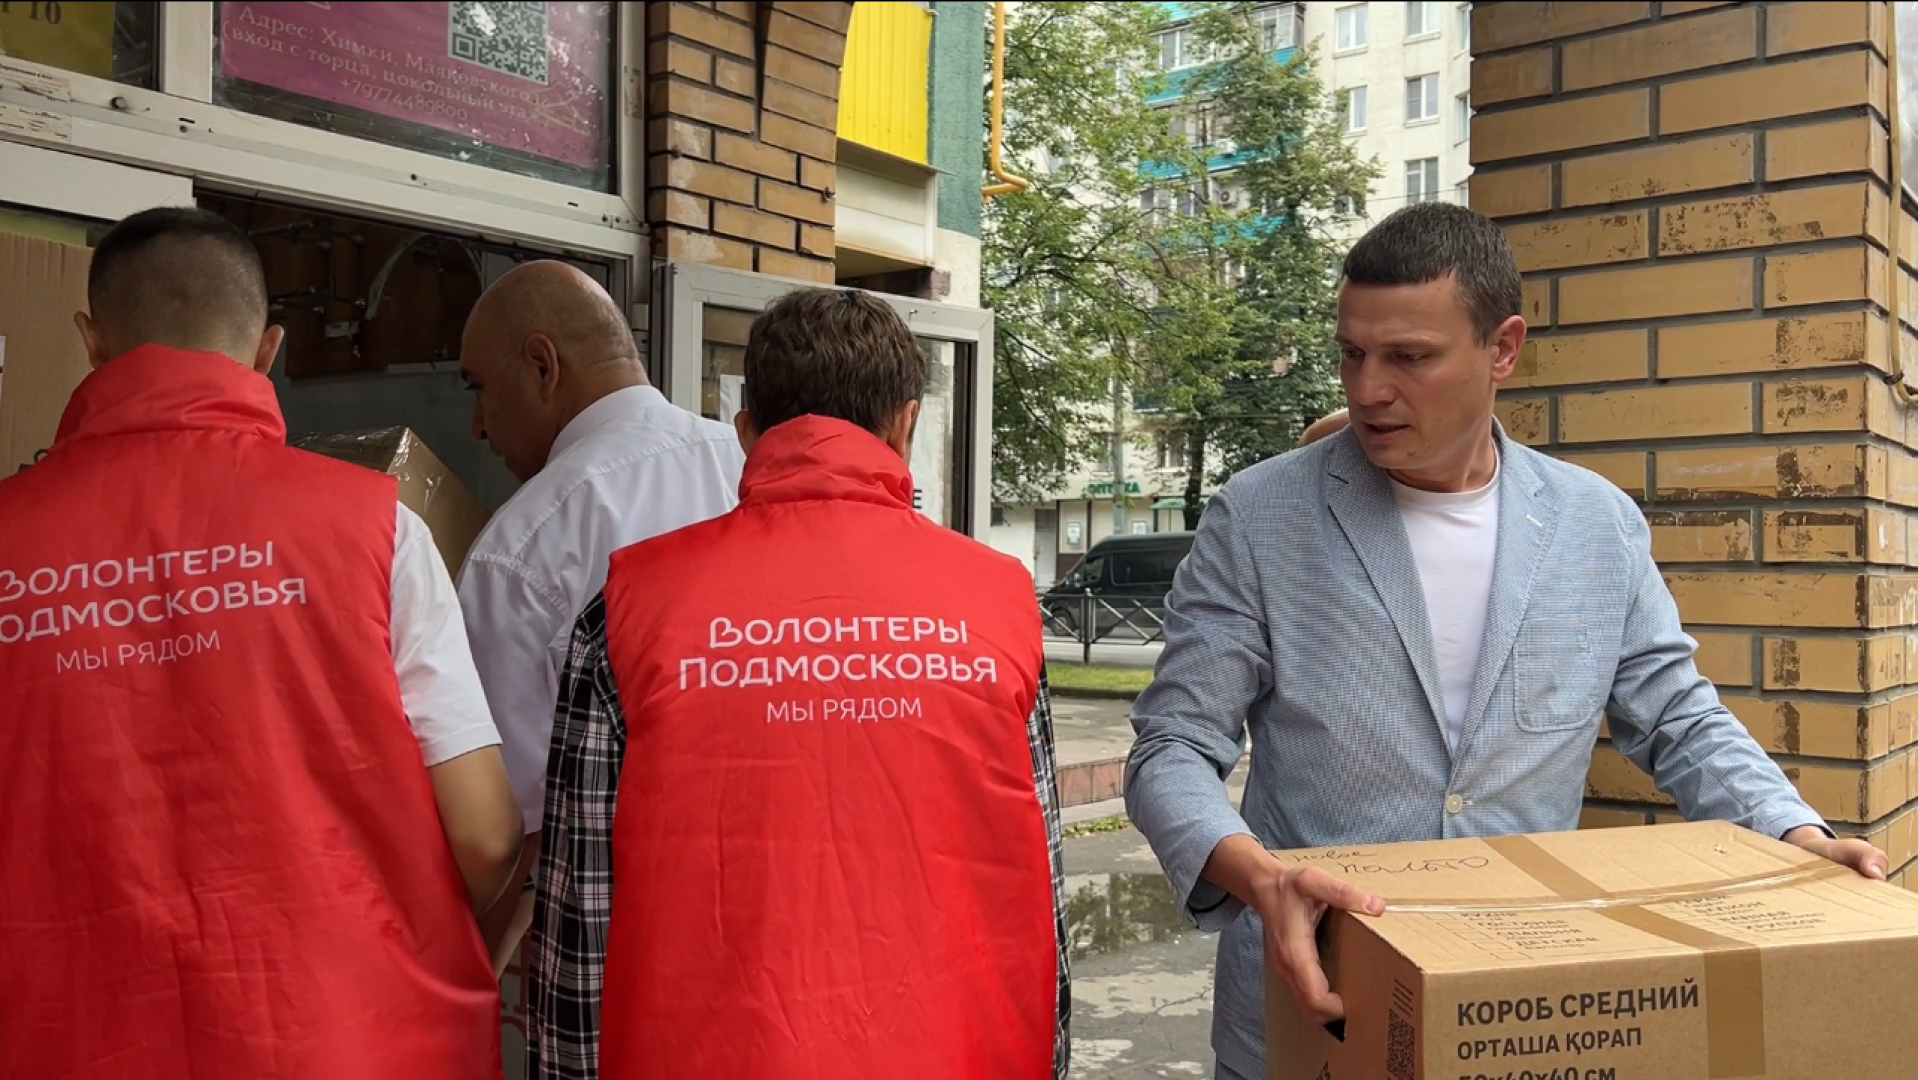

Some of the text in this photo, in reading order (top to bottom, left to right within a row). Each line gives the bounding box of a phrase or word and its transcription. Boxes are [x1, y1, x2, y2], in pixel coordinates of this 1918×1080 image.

[222, 20, 283, 53] (вход
[290, 44, 301, 57] с
[308, 49, 376, 80] торца,
[383, 69, 494, 110] цокольный
[239, 5, 314, 41] Адрес:
[405, 52, 529, 101] Маяковского
[341, 78, 468, 121] +79774489800
[0, 578, 307, 643] ОДМОСКОВЬЯ
[56, 630, 220, 673] МЫ РЯДОМ
[709, 616, 969, 649] ВОЛОНТЕРЫ
[679, 652, 997, 690] ПОДМОСКОВЬЯ
[767, 697, 922, 723] МЫ РЯДОМ
[1457, 977, 1699, 1027] КОРОБ СРЕДНИЙ
[1457, 1034, 1560, 1060] ОРТАША
